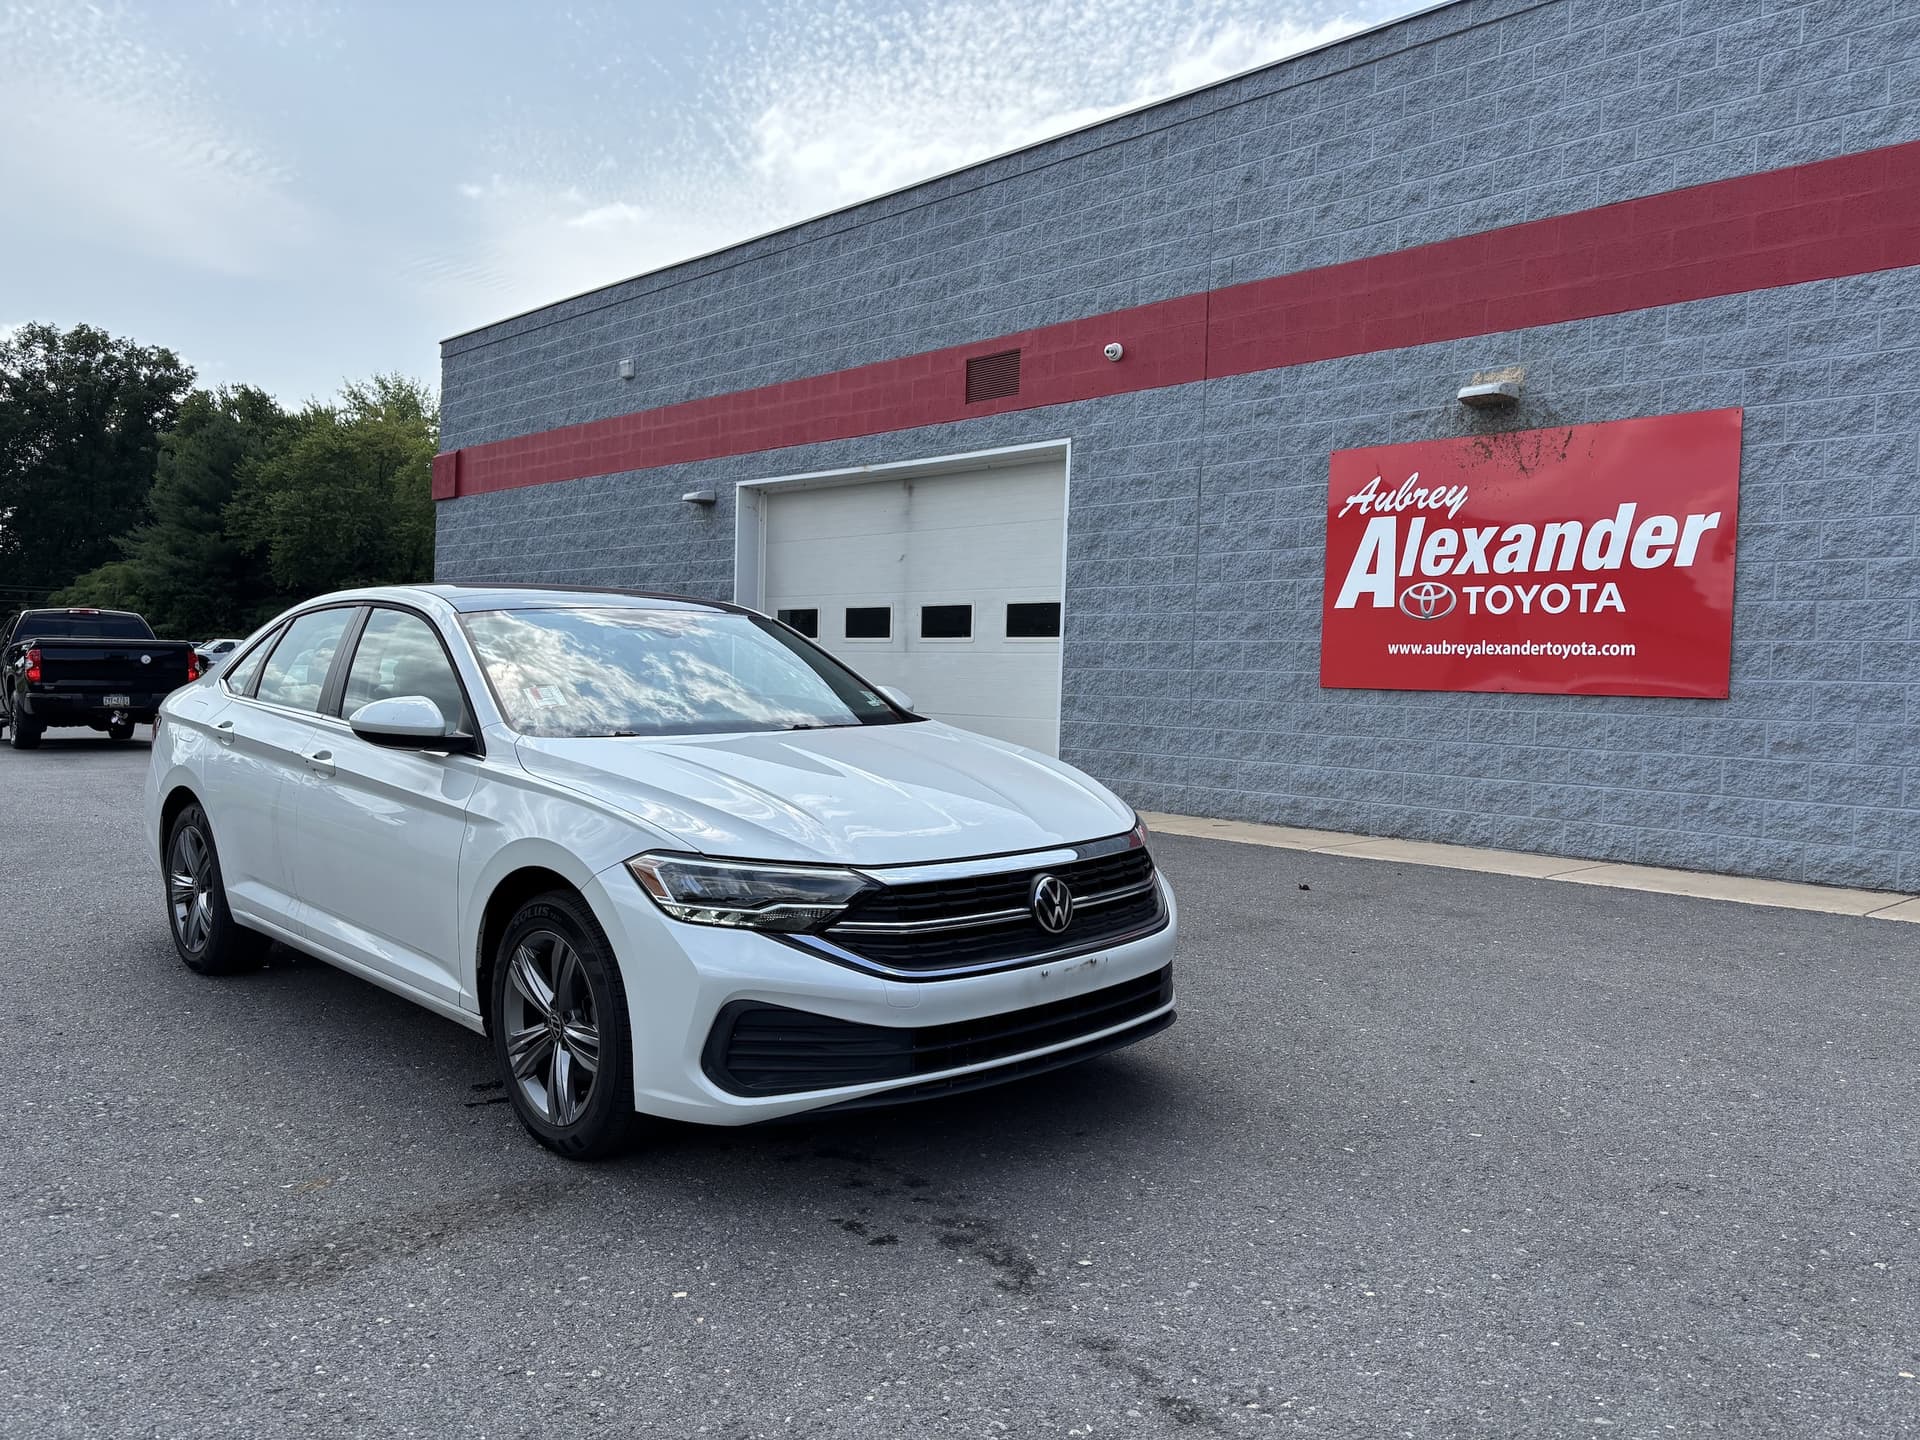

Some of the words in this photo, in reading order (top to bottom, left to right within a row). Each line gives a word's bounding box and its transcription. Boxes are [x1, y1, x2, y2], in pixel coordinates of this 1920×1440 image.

[1338, 472, 1469, 519] Aubrey
[1334, 503, 1722, 609] Alexander
[1463, 583, 1626, 615] TOYOTA
[1388, 640, 1636, 660] www.aubreyalexandertoyota.com
